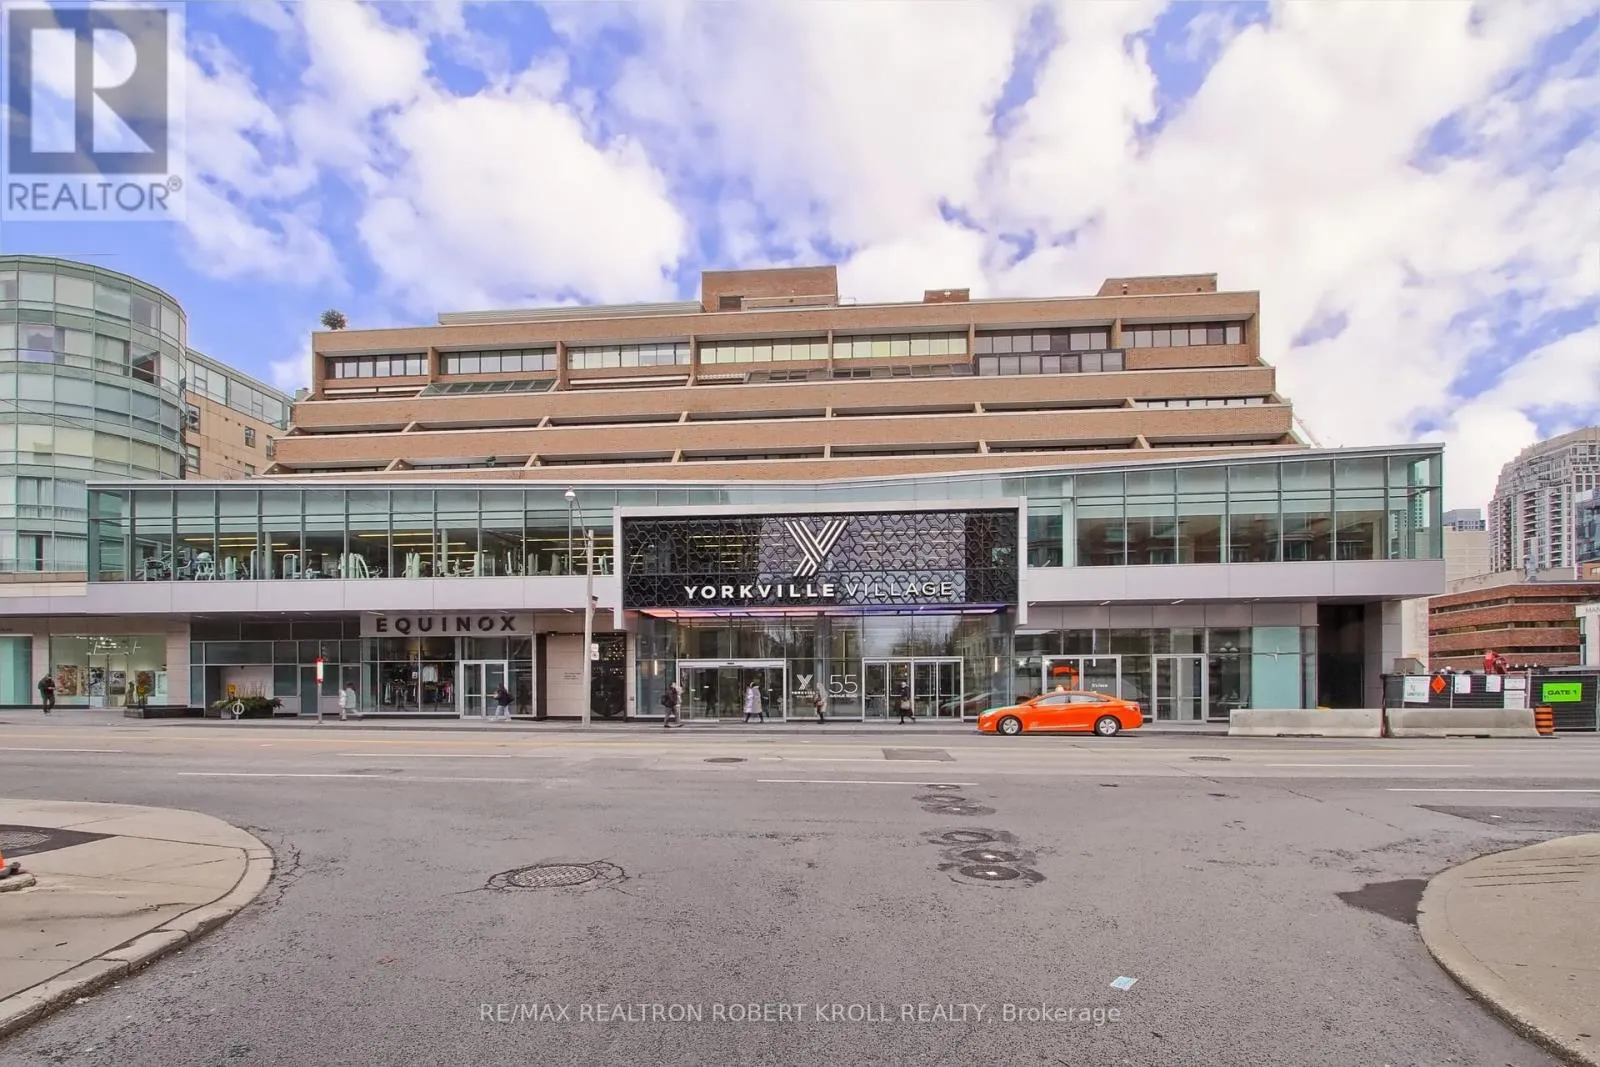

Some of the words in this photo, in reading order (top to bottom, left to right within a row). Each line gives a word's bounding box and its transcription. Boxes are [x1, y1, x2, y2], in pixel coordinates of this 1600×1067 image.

[685, 583, 835, 599] YORKVILLE
[844, 582, 953, 597] VILLAGE
[376, 616, 516, 635] EQUINOX
[829, 674, 858, 694] 55
